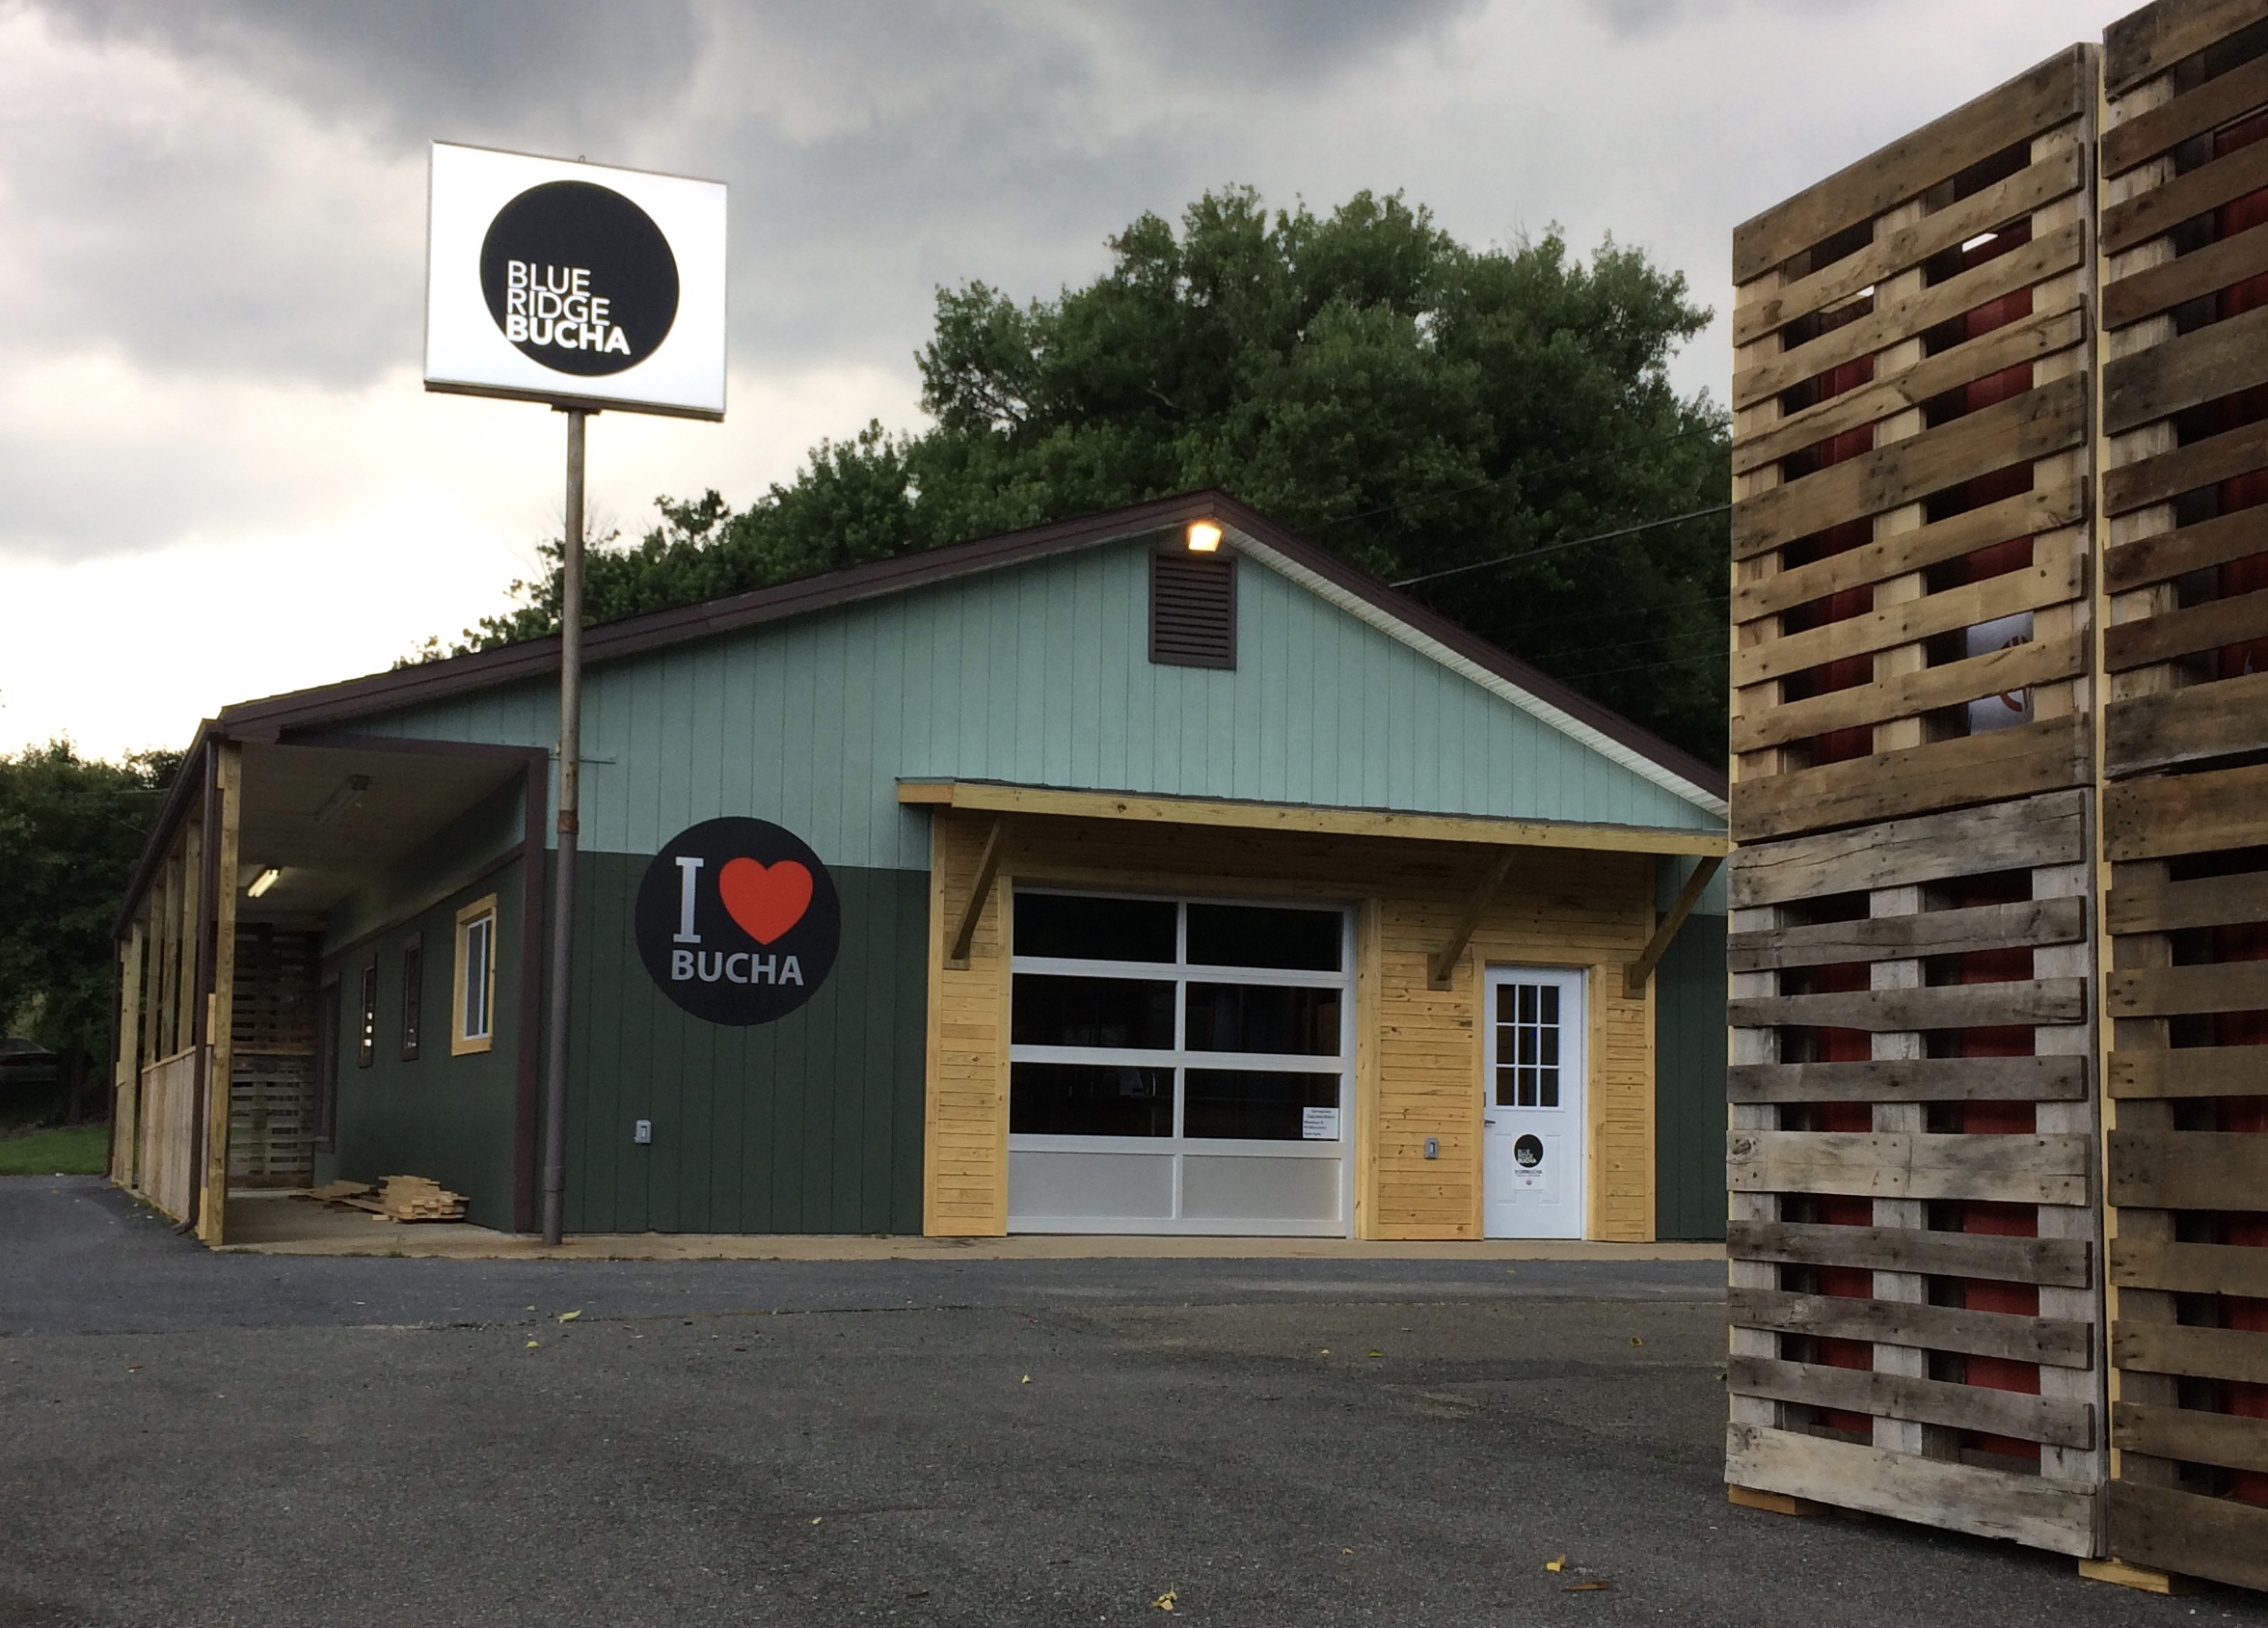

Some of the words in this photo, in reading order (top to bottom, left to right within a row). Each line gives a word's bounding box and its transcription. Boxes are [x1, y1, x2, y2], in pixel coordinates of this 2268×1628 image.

[507, 259, 591, 298] BLUE
[507, 287, 610, 326] RIDGE
[506, 313, 632, 356] BUCHA
[673, 856, 704, 944] I
[671, 950, 804, 986] BUCHA
